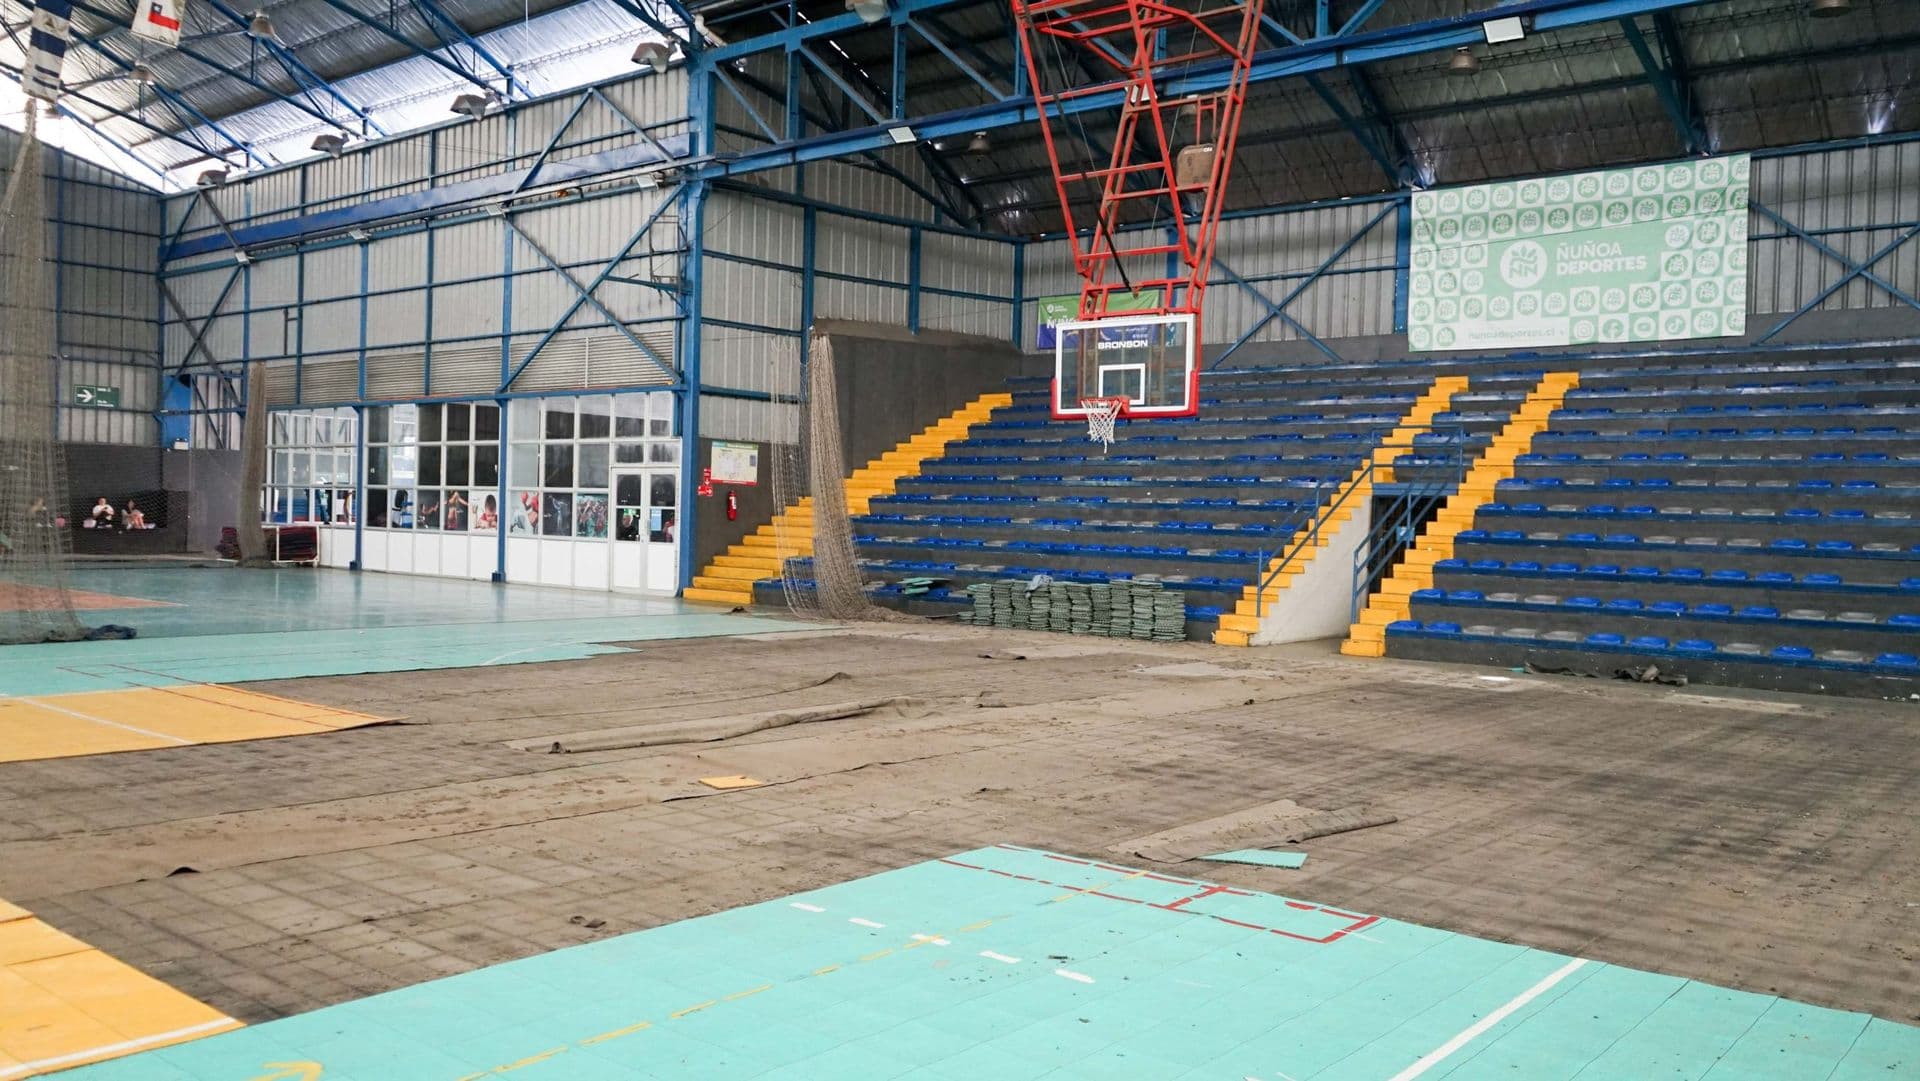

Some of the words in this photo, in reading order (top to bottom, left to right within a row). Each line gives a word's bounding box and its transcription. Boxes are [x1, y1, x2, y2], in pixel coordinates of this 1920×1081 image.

[1557, 240, 1622, 260] ÑUÑOA
[1557, 255, 1648, 276] DEPORTES
[1098, 339, 1148, 350] BRONSON
